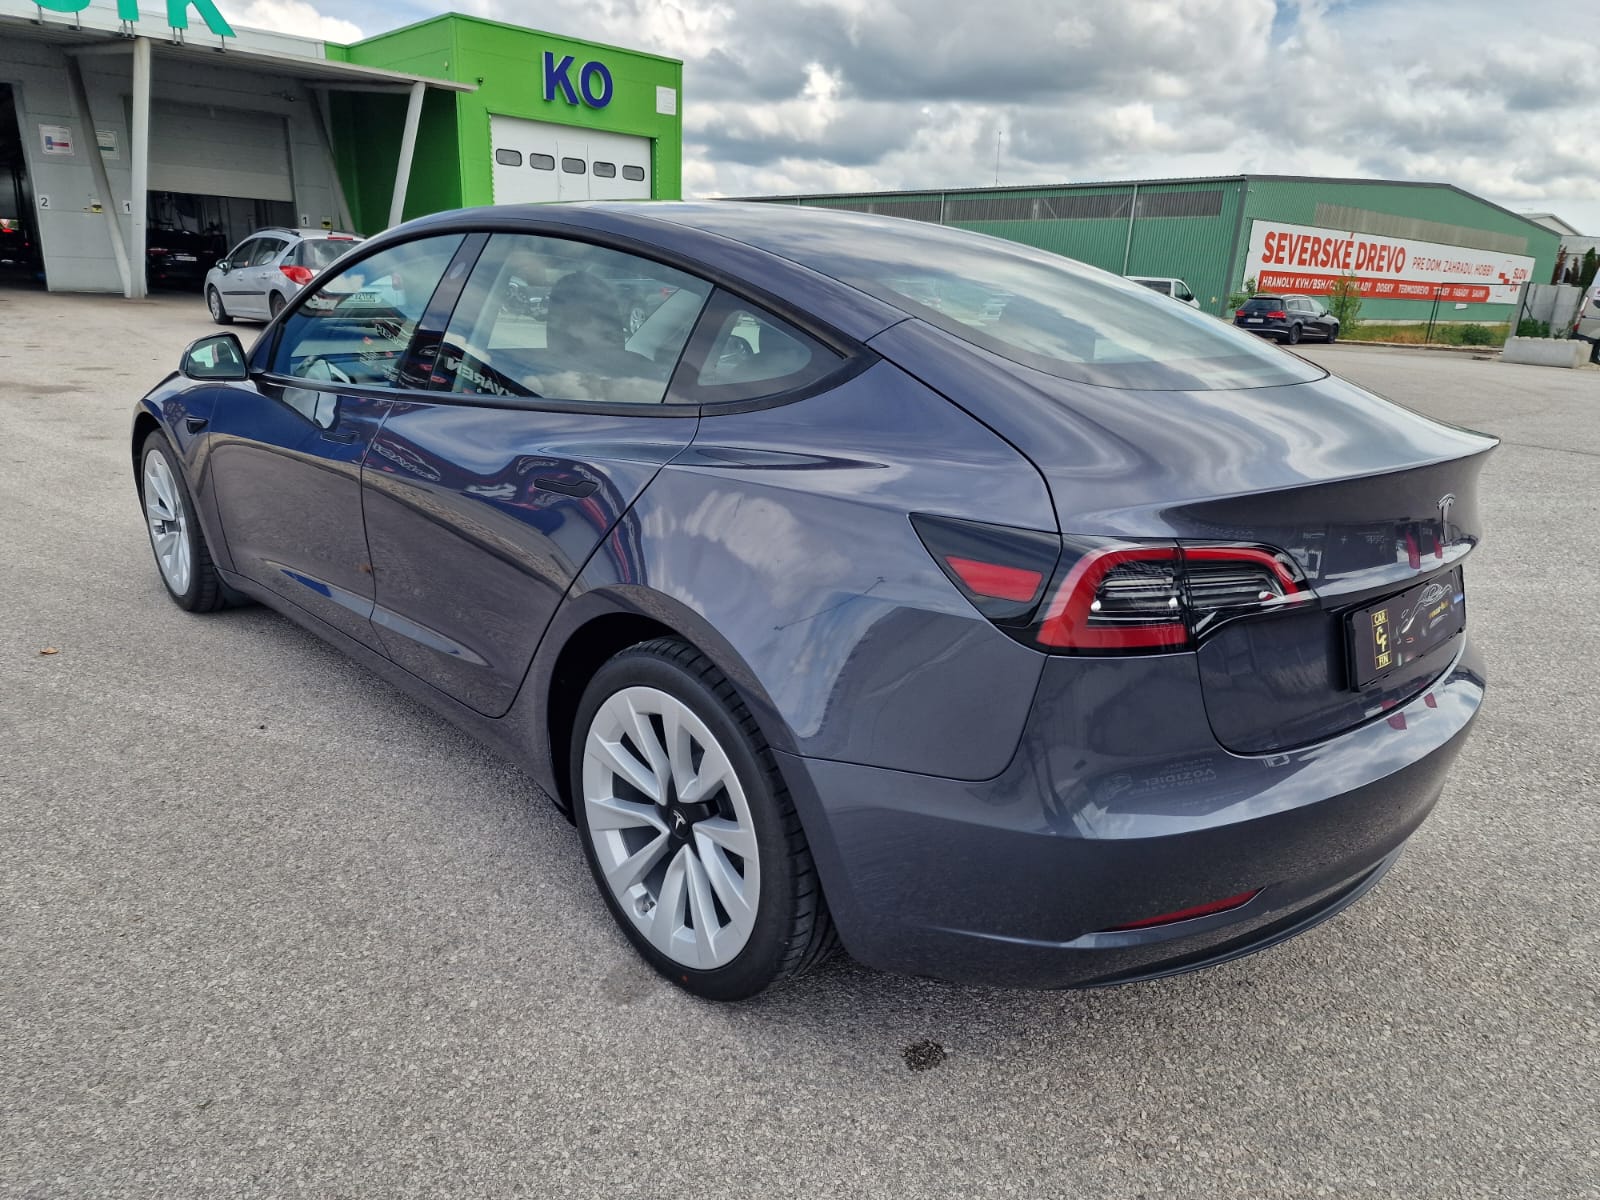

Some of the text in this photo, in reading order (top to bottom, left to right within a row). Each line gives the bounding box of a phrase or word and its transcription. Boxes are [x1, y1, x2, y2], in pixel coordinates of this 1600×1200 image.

[542, 51, 614, 109] KO
[40, 197, 49, 208] 2
[1261, 231, 1406, 274] SEVERSKÉ DREVO
[1262, 276, 1294, 288] HRANOLY
[1374, 612, 1386, 625] CAR
